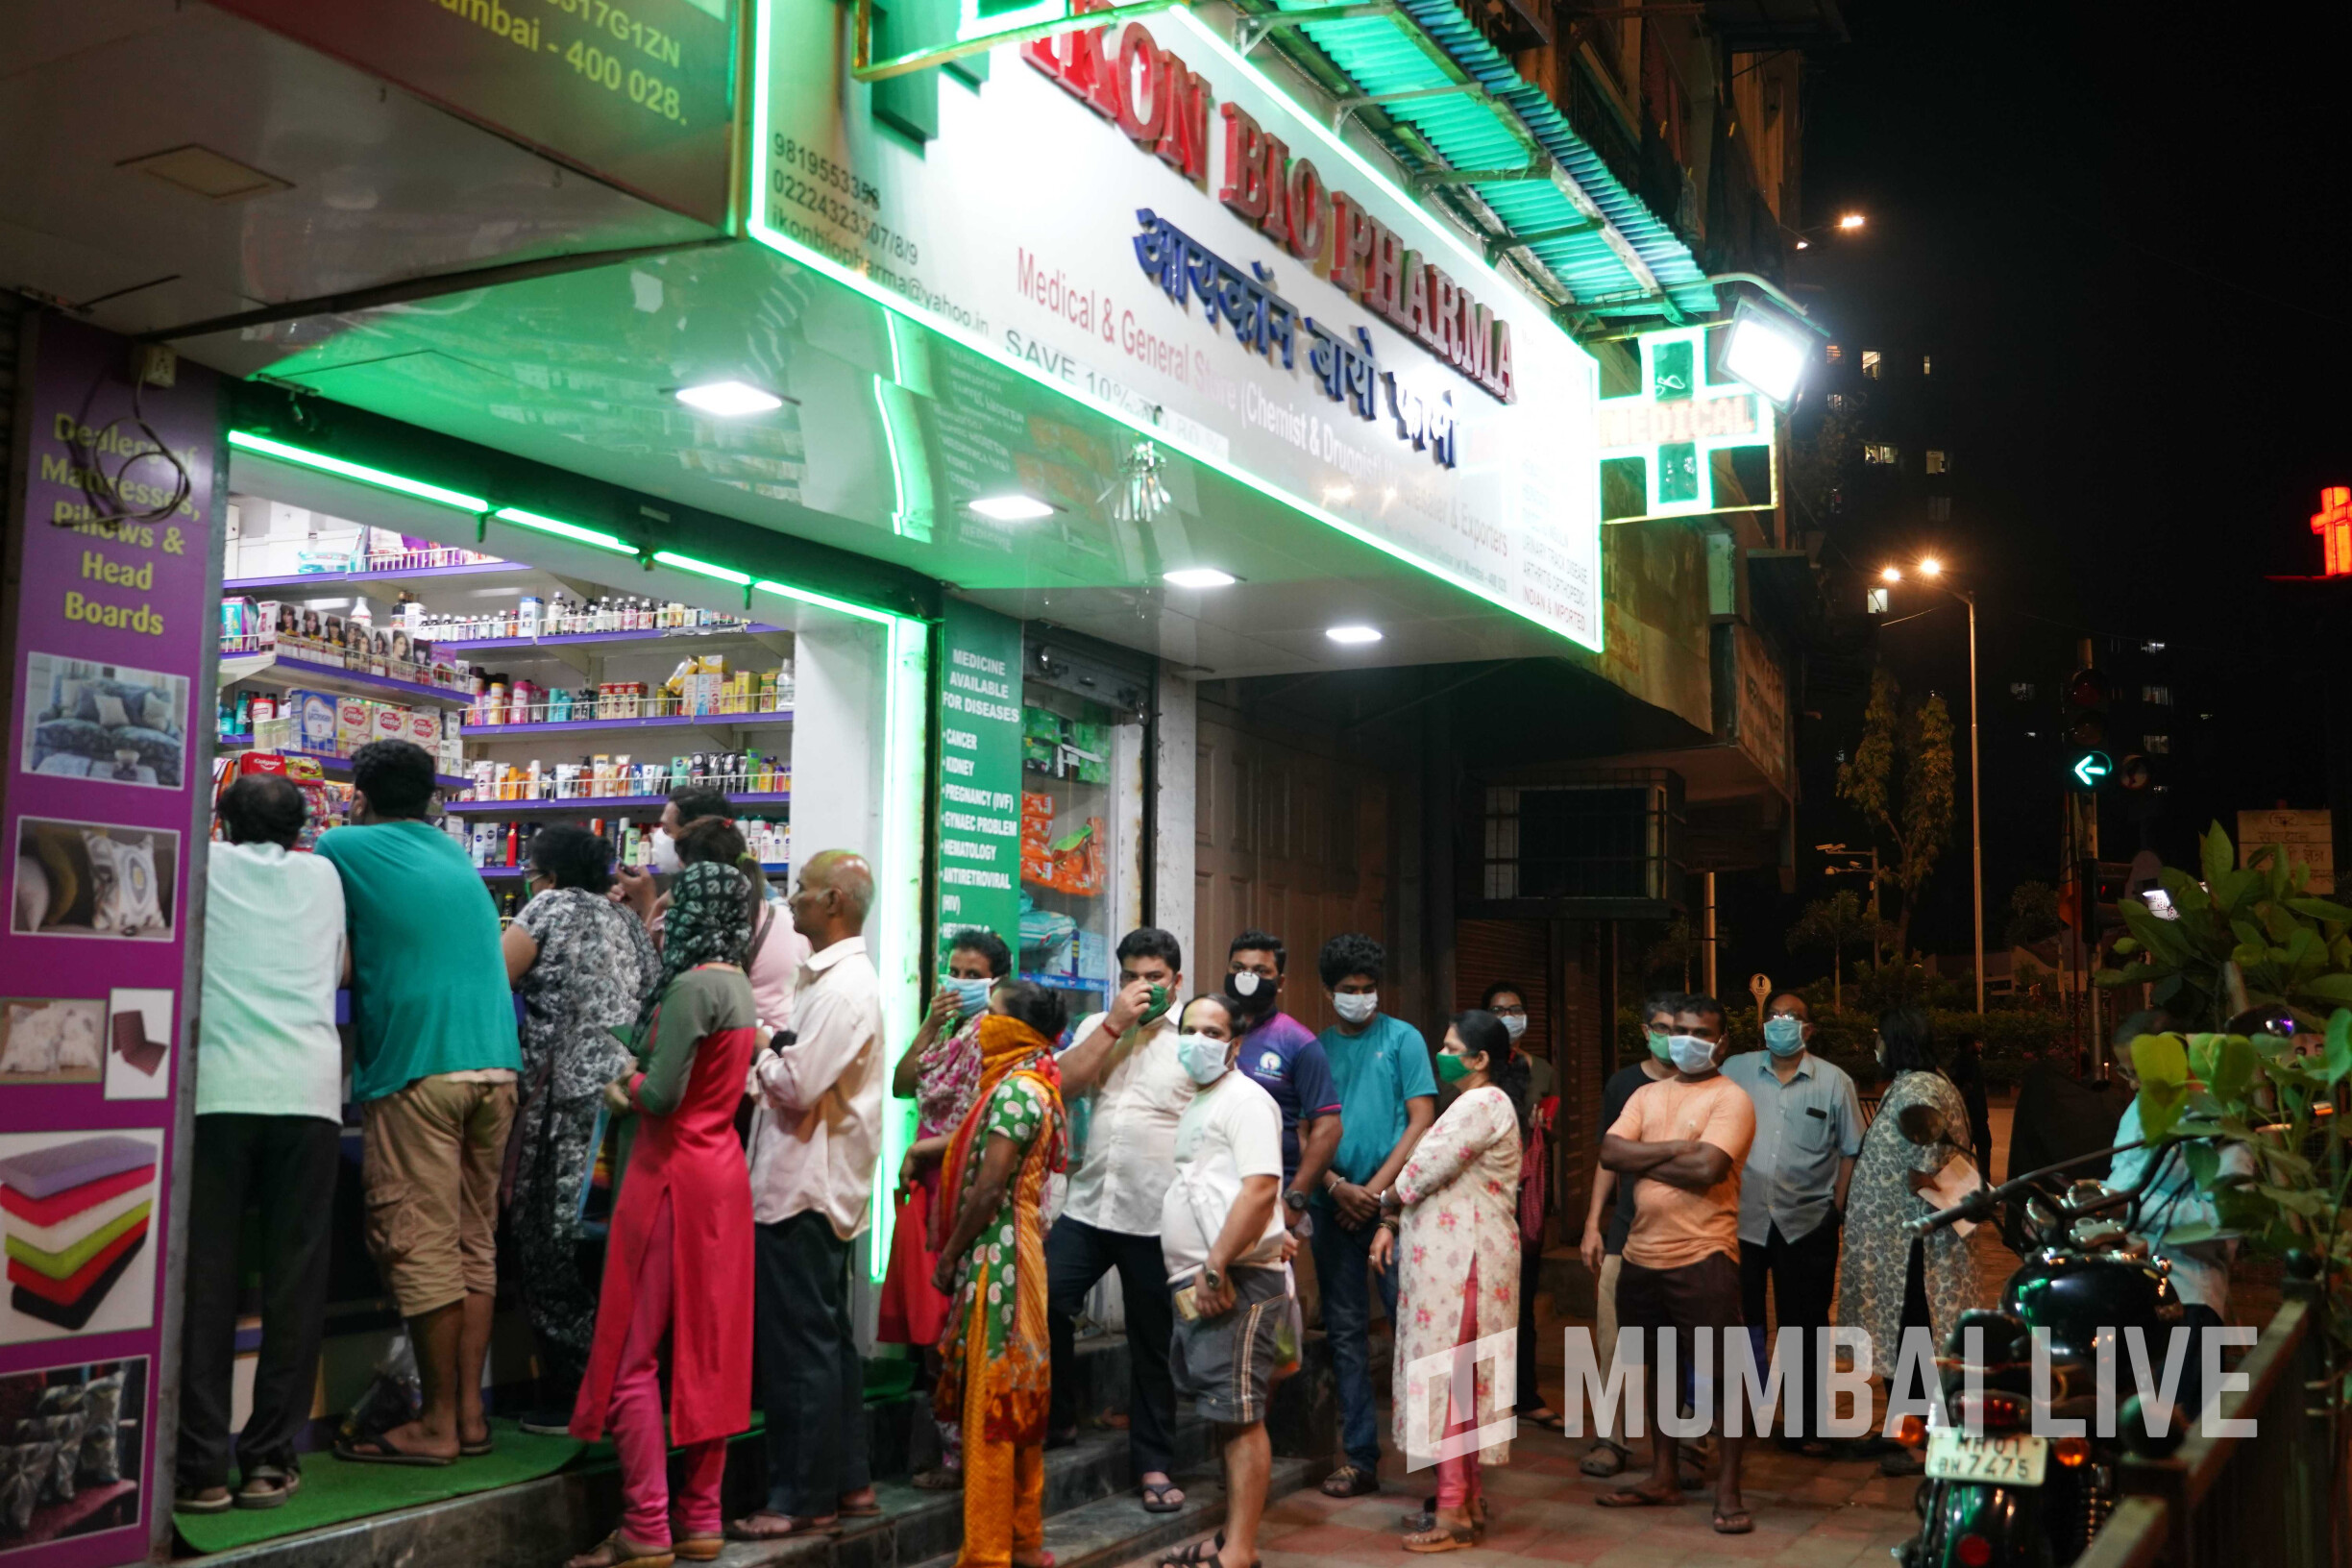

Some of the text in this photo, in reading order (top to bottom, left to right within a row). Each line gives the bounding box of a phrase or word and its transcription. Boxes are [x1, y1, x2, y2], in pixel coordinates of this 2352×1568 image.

[429, 0, 539, 51] mbai
[566, 40, 622, 91] 400
[629, 69, 687, 126] 028.
[1219, 101, 1326, 261] BIO
[1330, 190, 1517, 406] PHARMA
[1006, 330, 1077, 383] SAVE
[1087, 371, 1134, 411] 10%
[1018, 247, 1095, 335] Medical
[1102, 298, 1115, 345] &
[1122, 309, 1189, 384] General
[1194, 349, 1237, 412] Store
[1240, 377, 1308, 451] (Chemist
[1310, 415, 1321, 457] &
[1461, 502, 1508, 558] Exporters
[161, 526, 186, 556] &
[82, 551, 154, 591] Head
[64, 591, 164, 636] Boards
[1523, 584, 1546, 612] INDIAN
[1555, 600, 1586, 632] IMPORTED
[952, 648, 1006, 676] MEDICINE
[949, 671, 1009, 699] AVAILABLE
[943, 691, 1020, 723] FOR DISEASES
[945, 727, 978, 751] CANCER
[944, 755, 975, 777] KIDNEY
[944, 782, 1014, 814] PREGNANCY (IVF)
[944, 810, 1017, 837] GYNAEC PROBLEM
[943, 838, 996, 861] HEMATOLOGY
[943, 867, 1012, 890] ANTIRETROVIRAL
